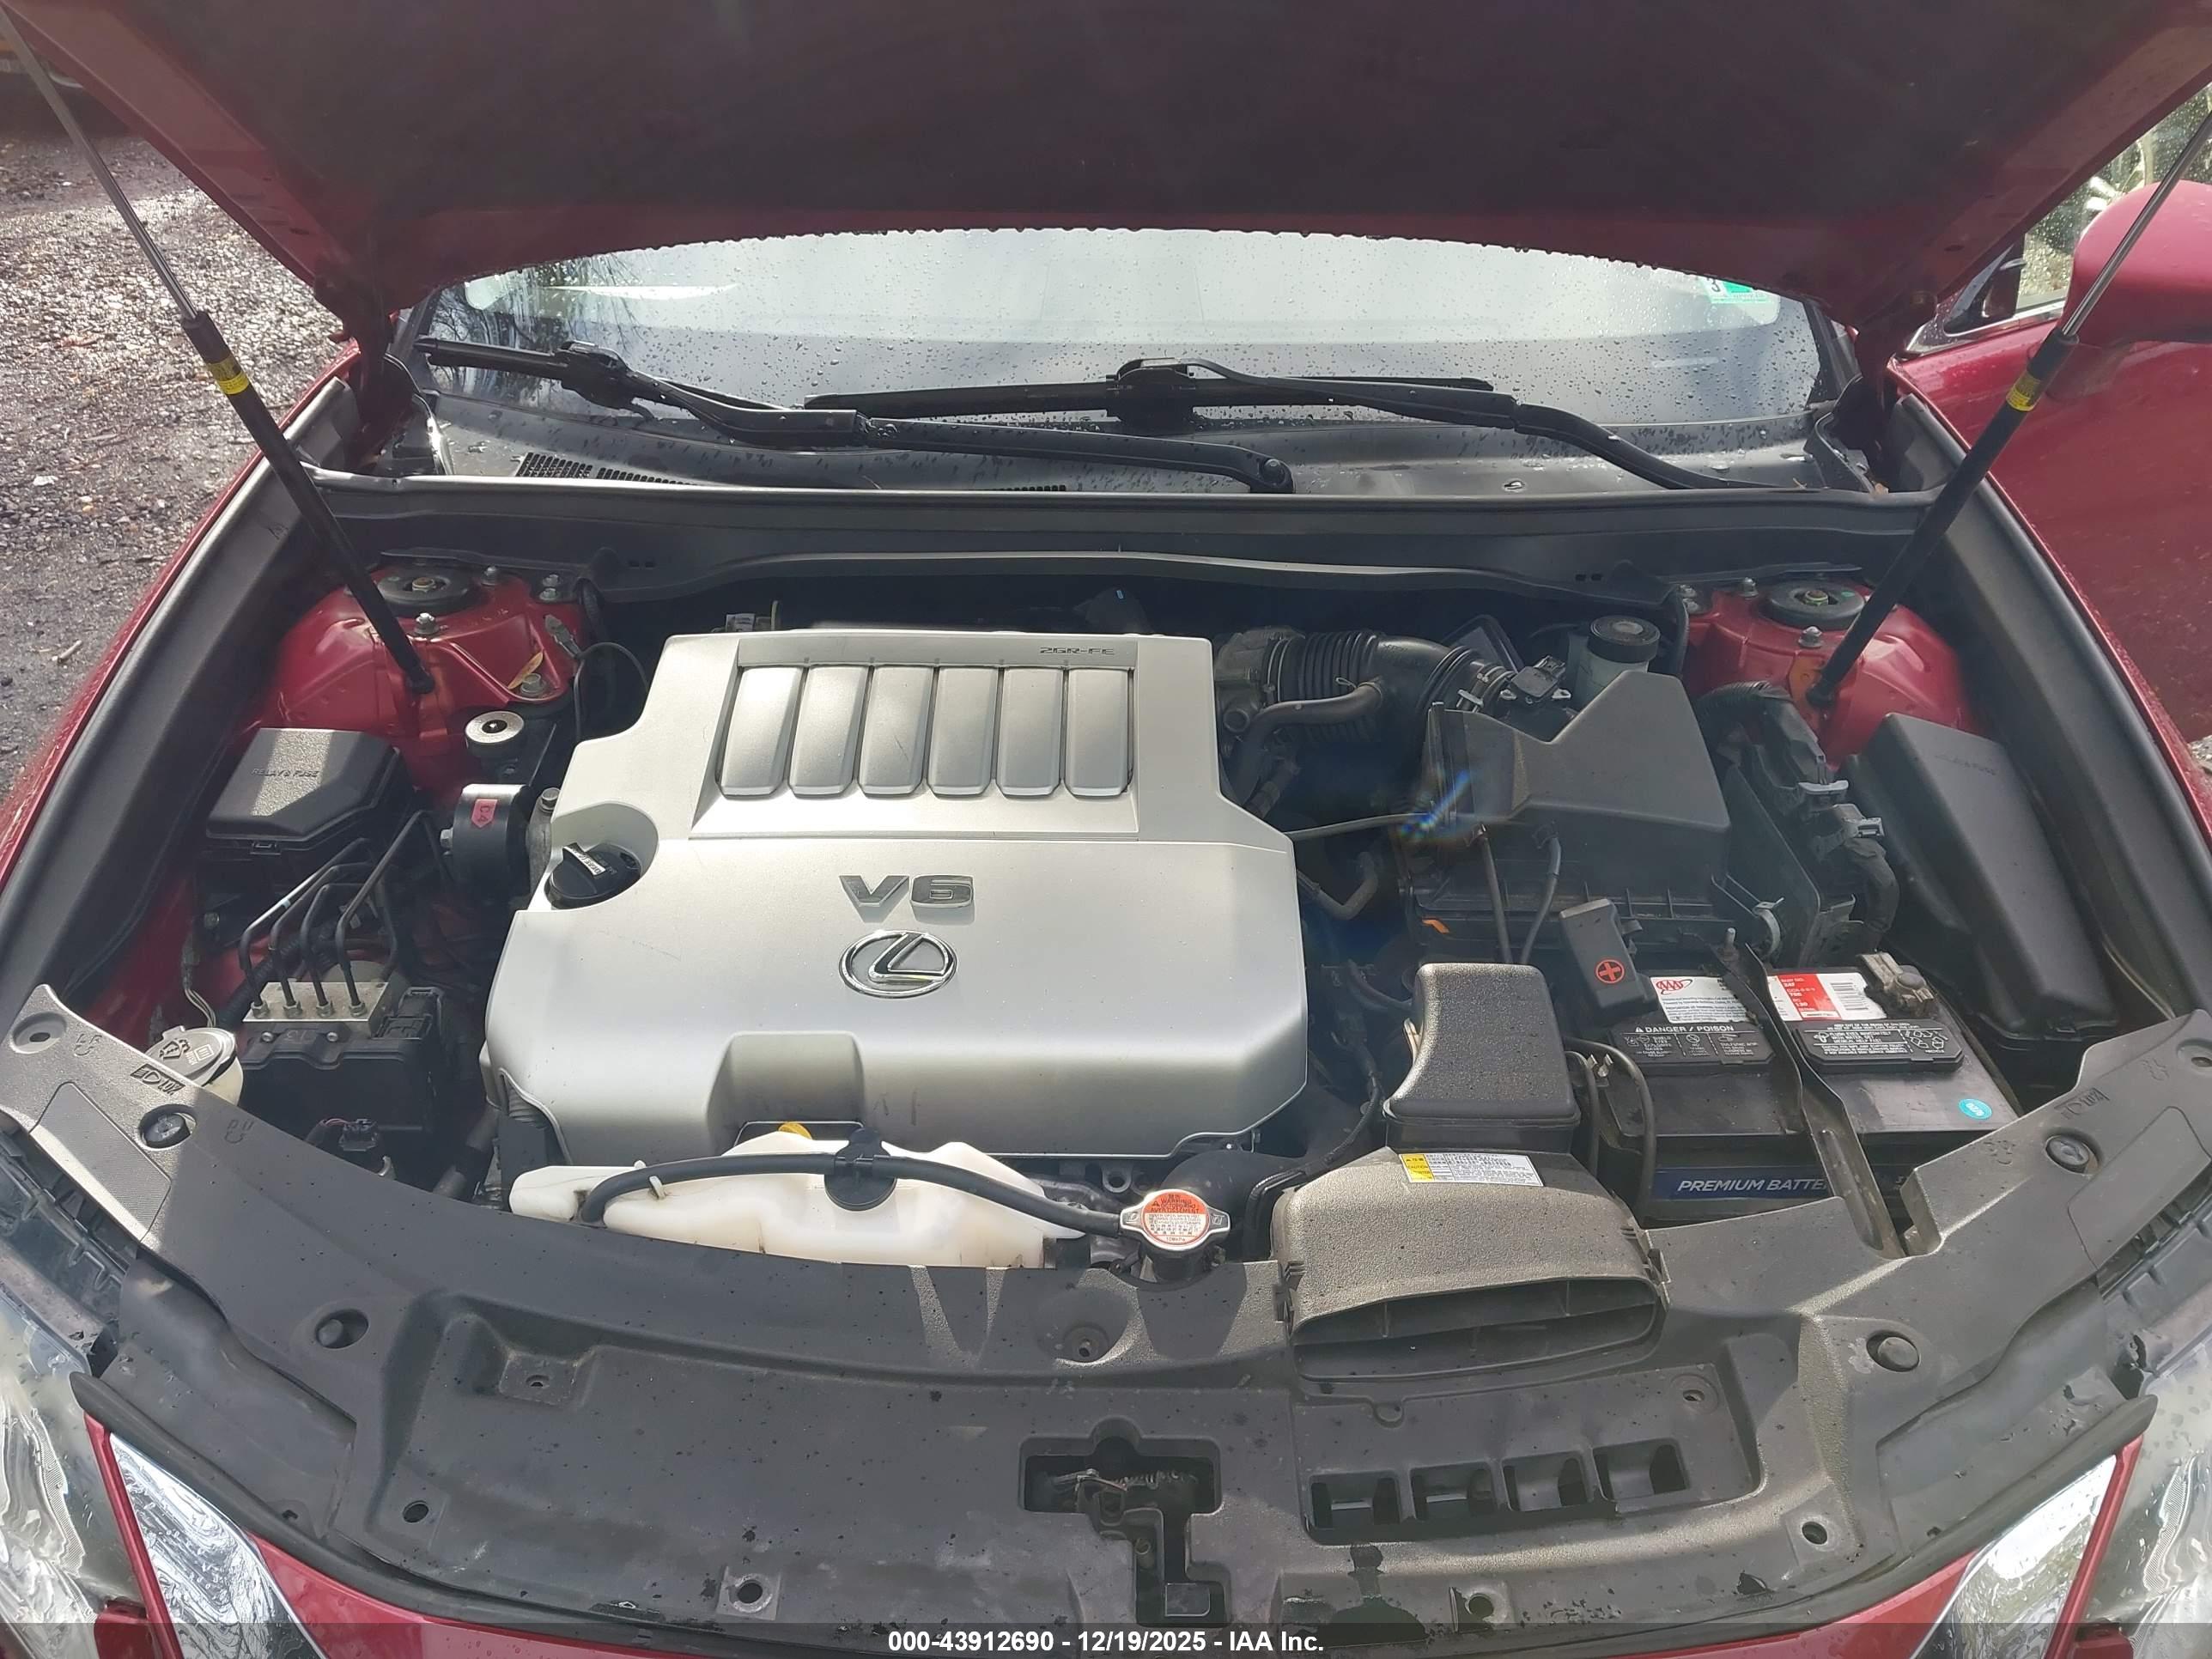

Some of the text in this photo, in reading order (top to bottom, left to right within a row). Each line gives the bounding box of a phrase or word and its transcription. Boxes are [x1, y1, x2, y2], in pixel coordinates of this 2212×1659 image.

[1040, 647, 1115, 655] 2GR-FE
[839, 874, 975, 922] V6
[1656, 979, 1685, 991] AAA
[1677, 1178, 1828, 1192] PREMIUM BATTE
